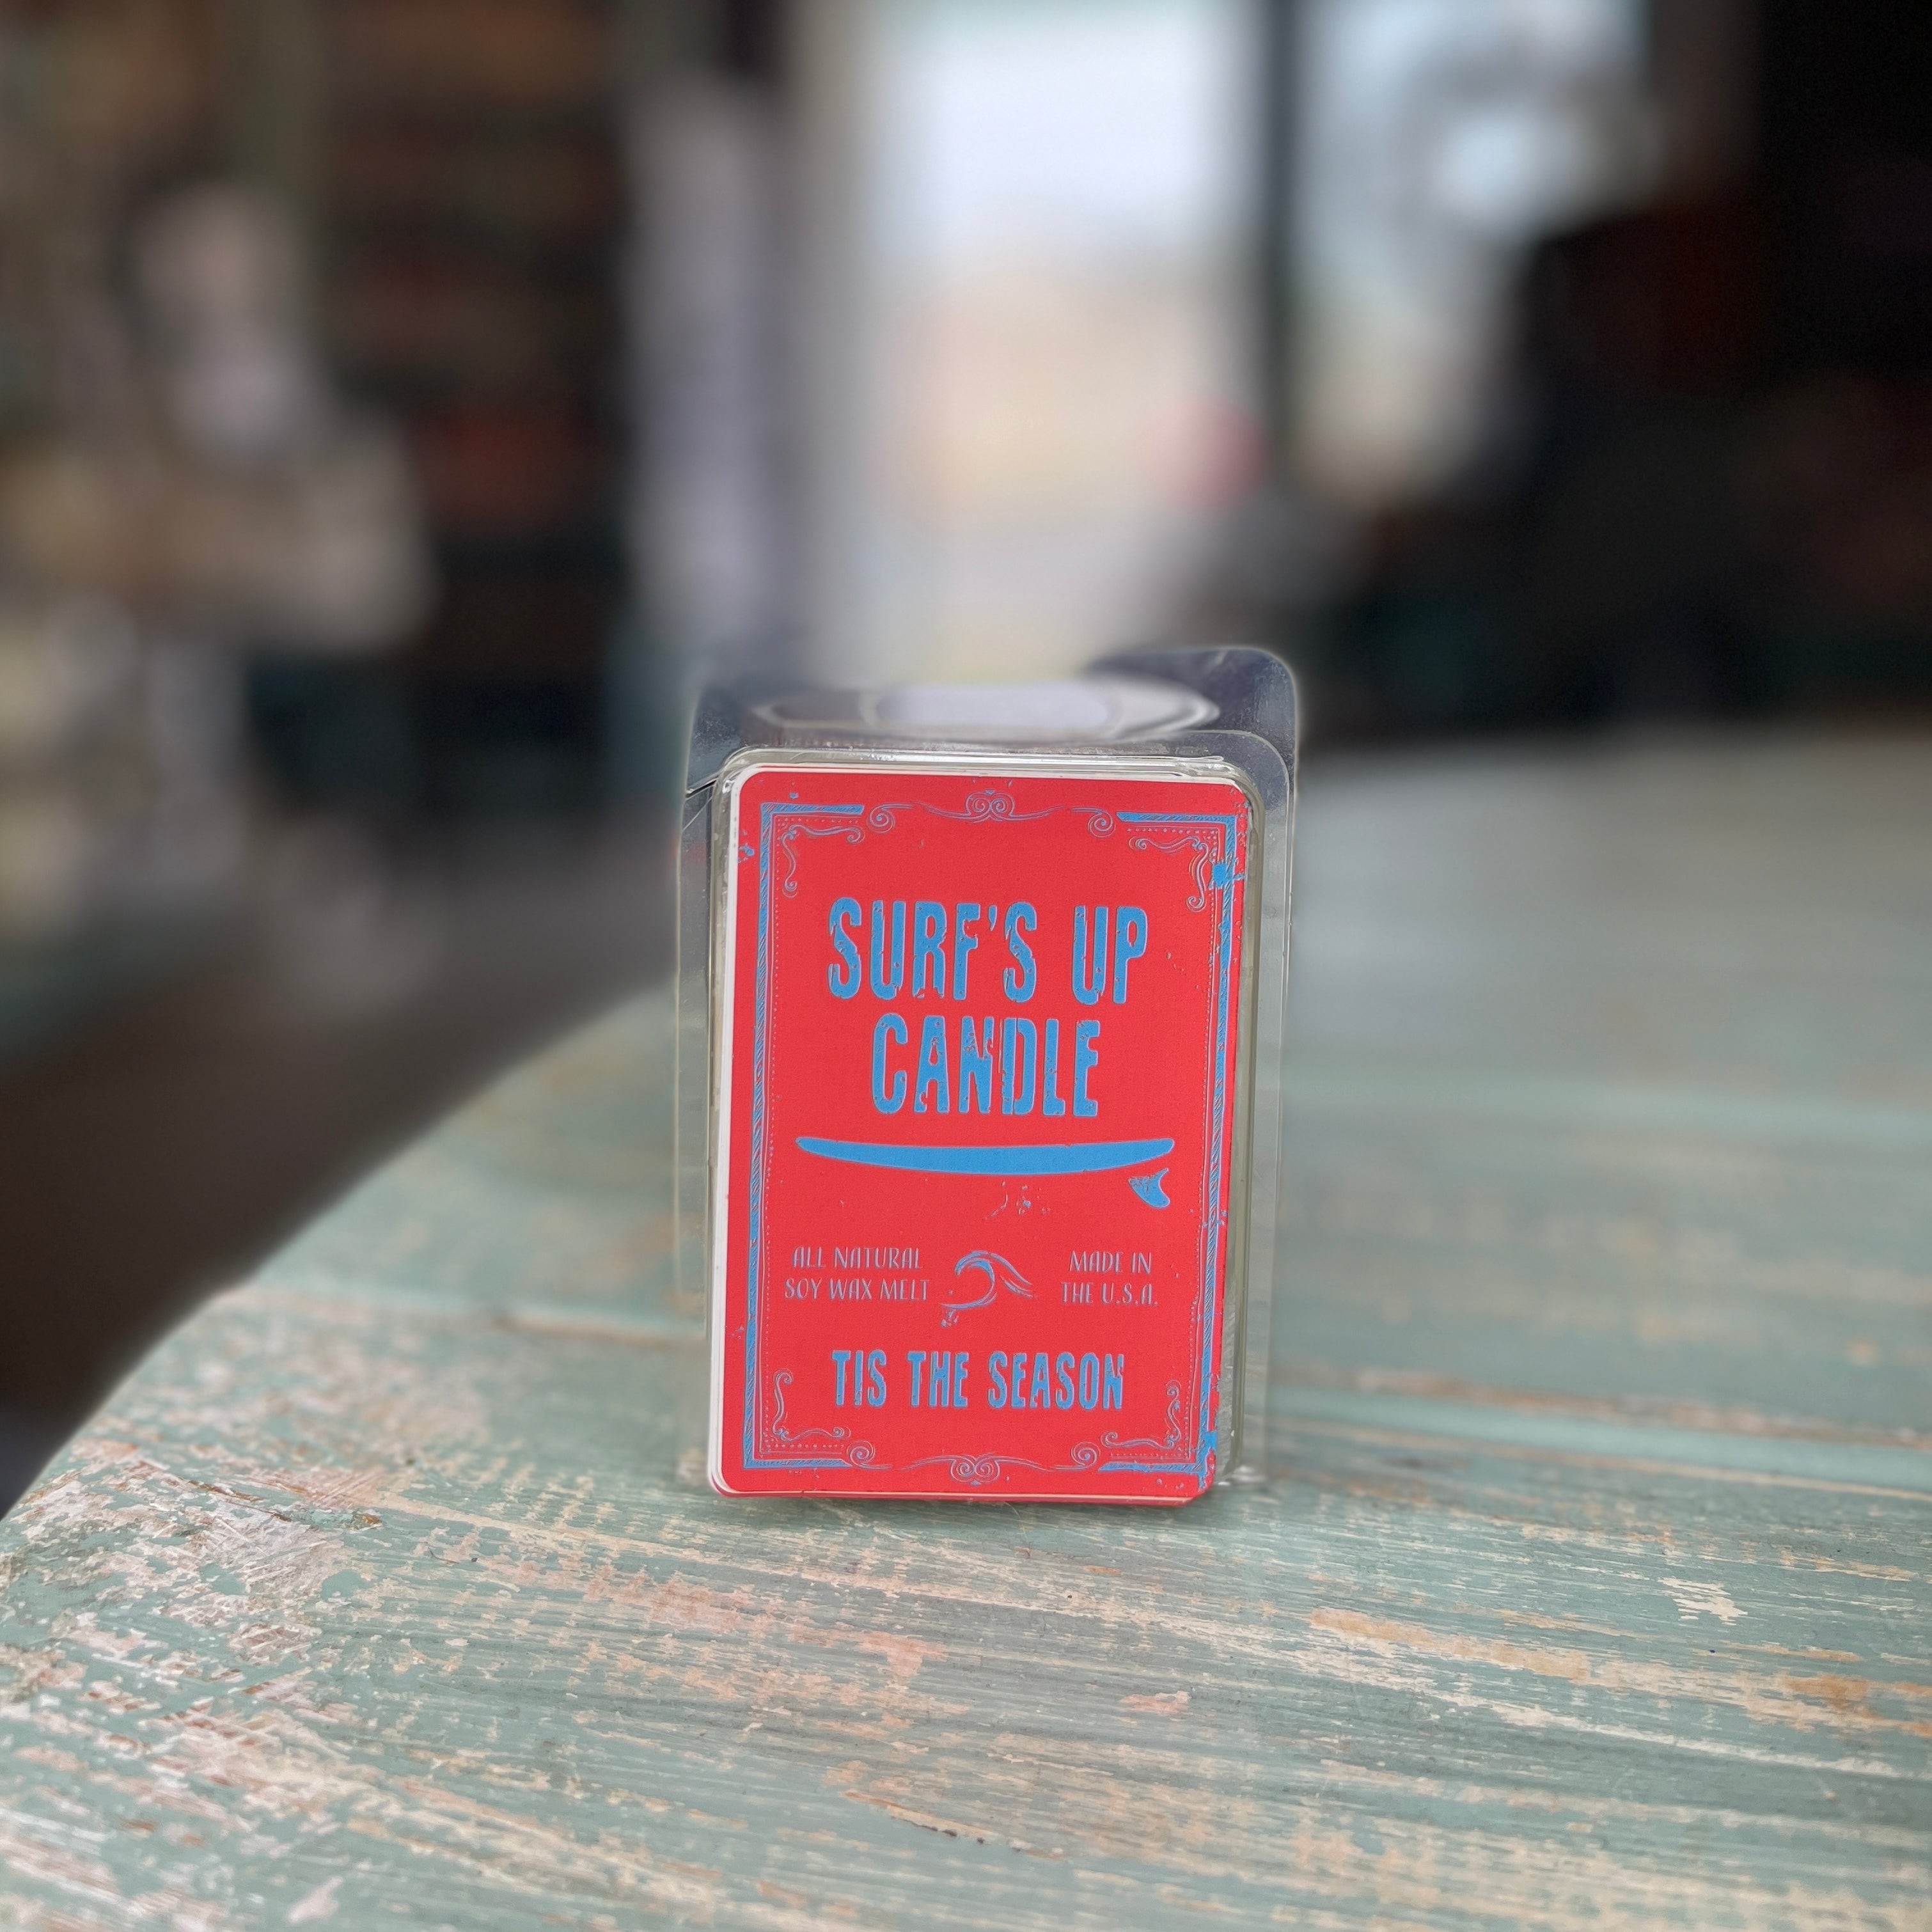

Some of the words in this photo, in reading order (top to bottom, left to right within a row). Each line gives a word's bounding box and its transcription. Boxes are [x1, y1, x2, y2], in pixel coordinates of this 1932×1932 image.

[828, 897, 1037, 1003] SURF'S
[1072, 905, 1148, 1005] UP
[872, 1013, 1101, 1117] CANDLE
[792, 1245, 826, 1268] ALL
[833, 1246, 923, 1269] NATURAL
[1069, 1250, 1124, 1273] MADE
[1131, 1252, 1152, 1274] IN
[784, 1277, 822, 1300] SOY
[828, 1278, 872, 1300] WAX
[879, 1278, 929, 1301] MELT
[1061, 1282, 1094, 1304] THE
[1101, 1282, 1158, 1306] U.S.A.
[831, 1349, 886, 1407] TIS
[907, 1351, 969, 1408] THE
[987, 1351, 1124, 1410] SEASON
